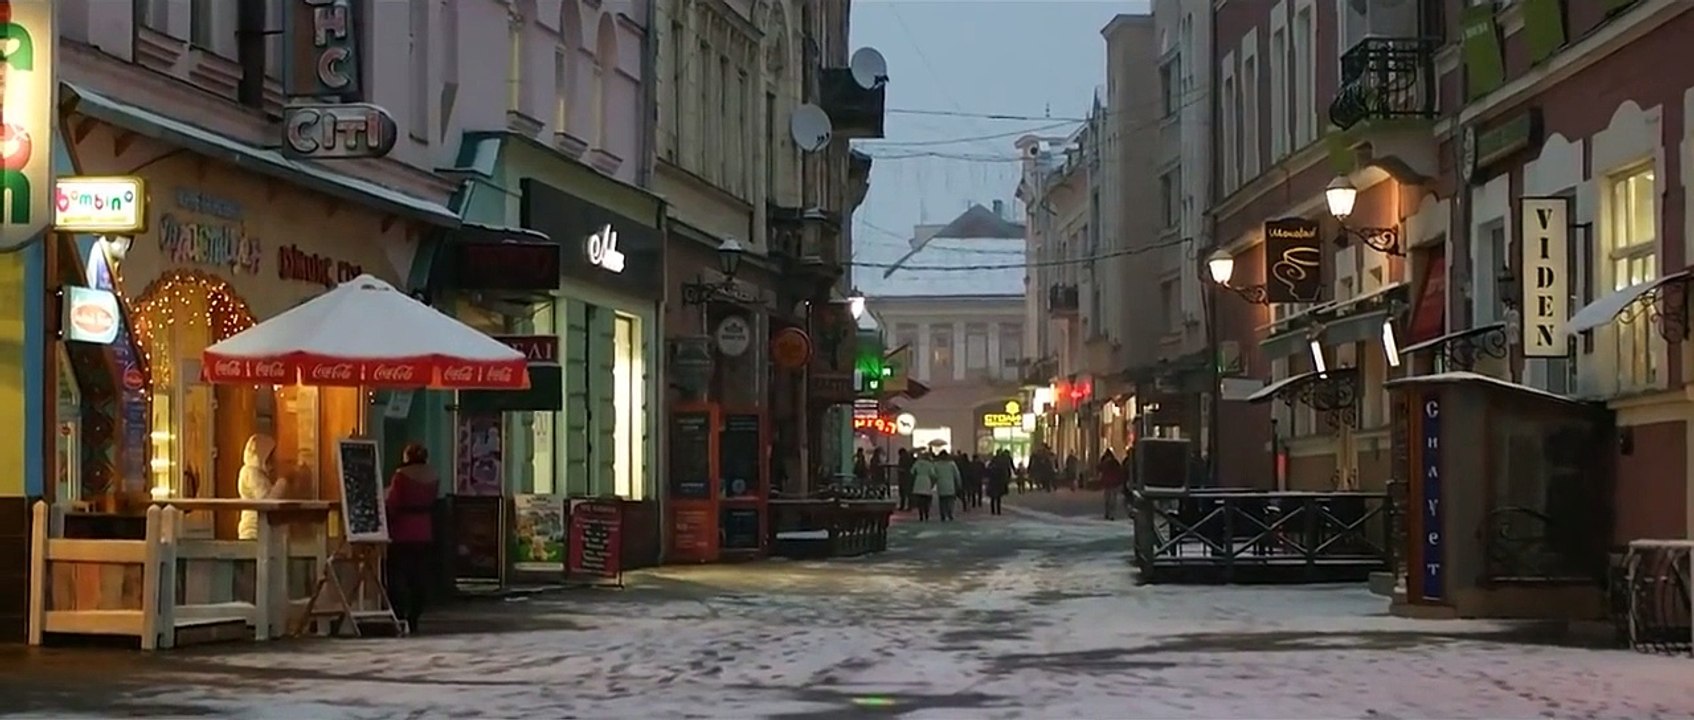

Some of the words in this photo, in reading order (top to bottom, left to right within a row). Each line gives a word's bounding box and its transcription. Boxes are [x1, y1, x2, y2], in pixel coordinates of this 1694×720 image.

[1537, 208, 1554, 347] VIDEN
[312, 363, 353, 379] Coca-Cola
[373, 364, 414, 380] Coca-Cola
